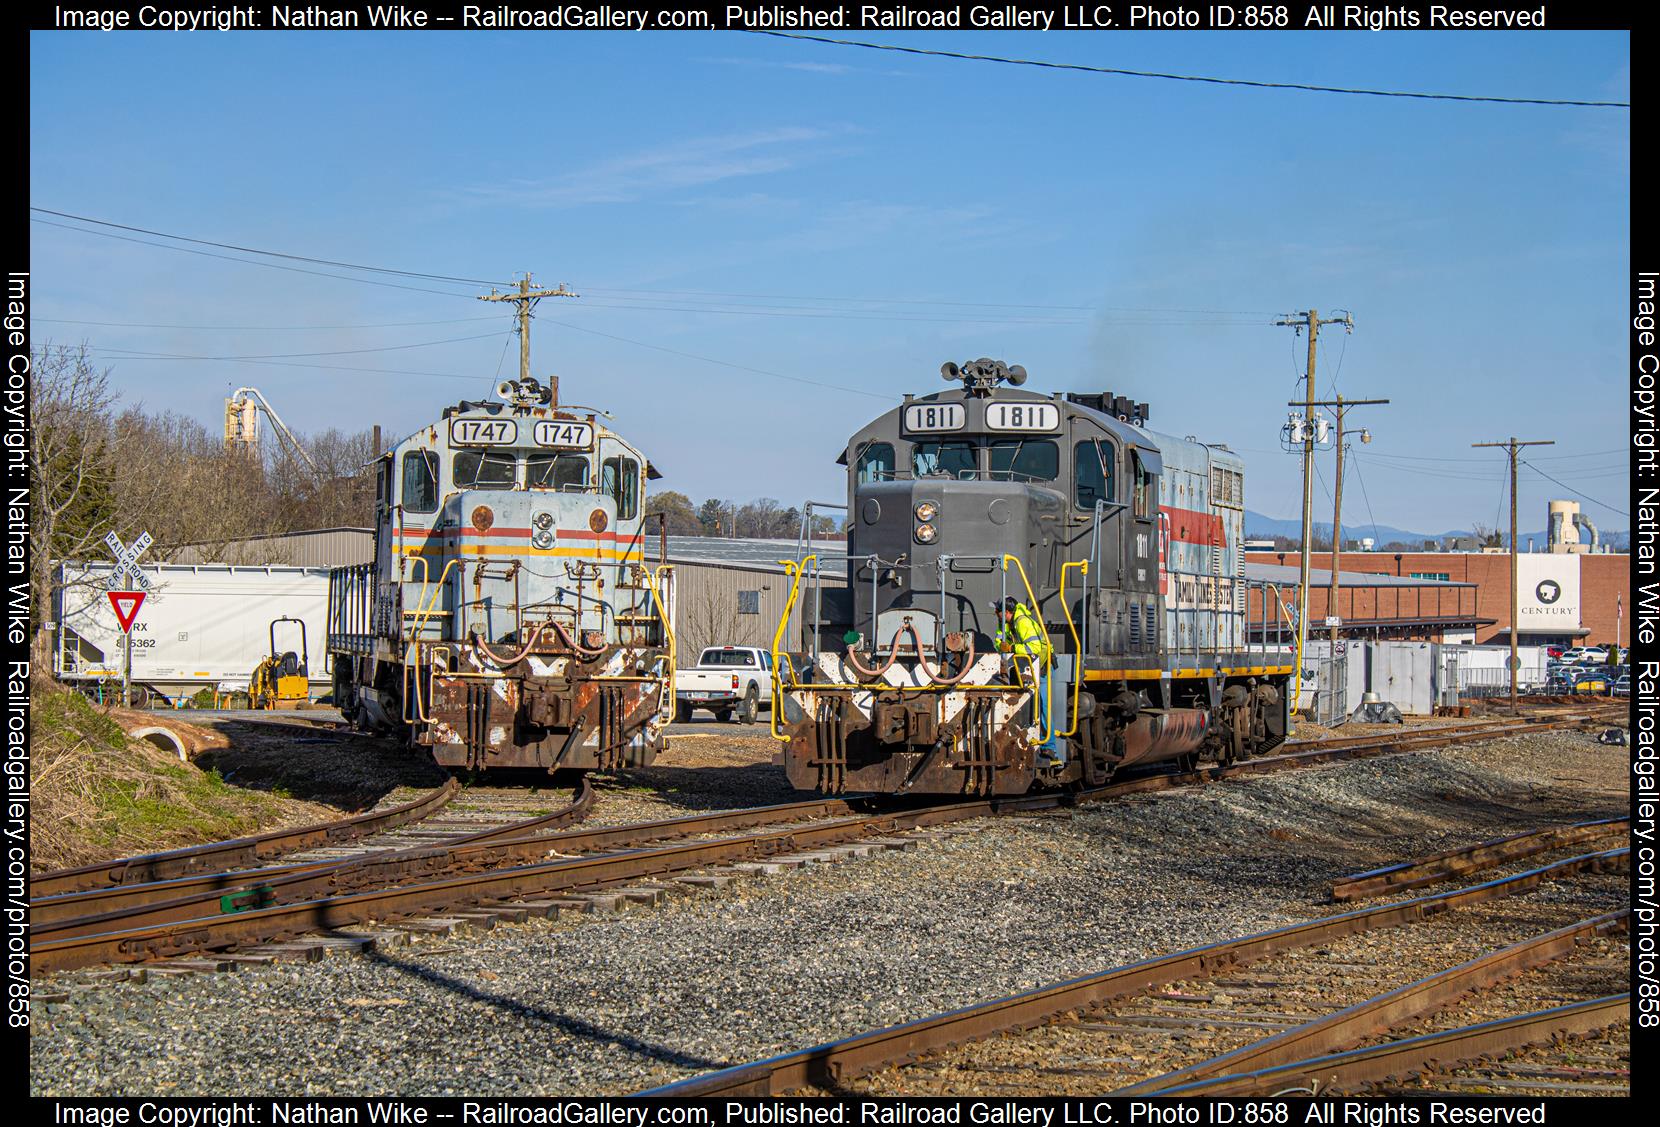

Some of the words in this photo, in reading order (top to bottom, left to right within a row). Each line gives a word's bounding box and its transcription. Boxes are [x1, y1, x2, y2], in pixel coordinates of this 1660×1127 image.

[916, 406, 954, 428] 1811
[1000, 406, 1044, 428] 1811
[461, 422, 508, 441] 1747
[543, 424, 585, 444] 1747
[1136, 533, 1148, 558] 1811
[108, 535, 151, 587] CROSSING
[1521, 607, 1573, 615] CENTURY
[116, 638, 156, 648] 85362
